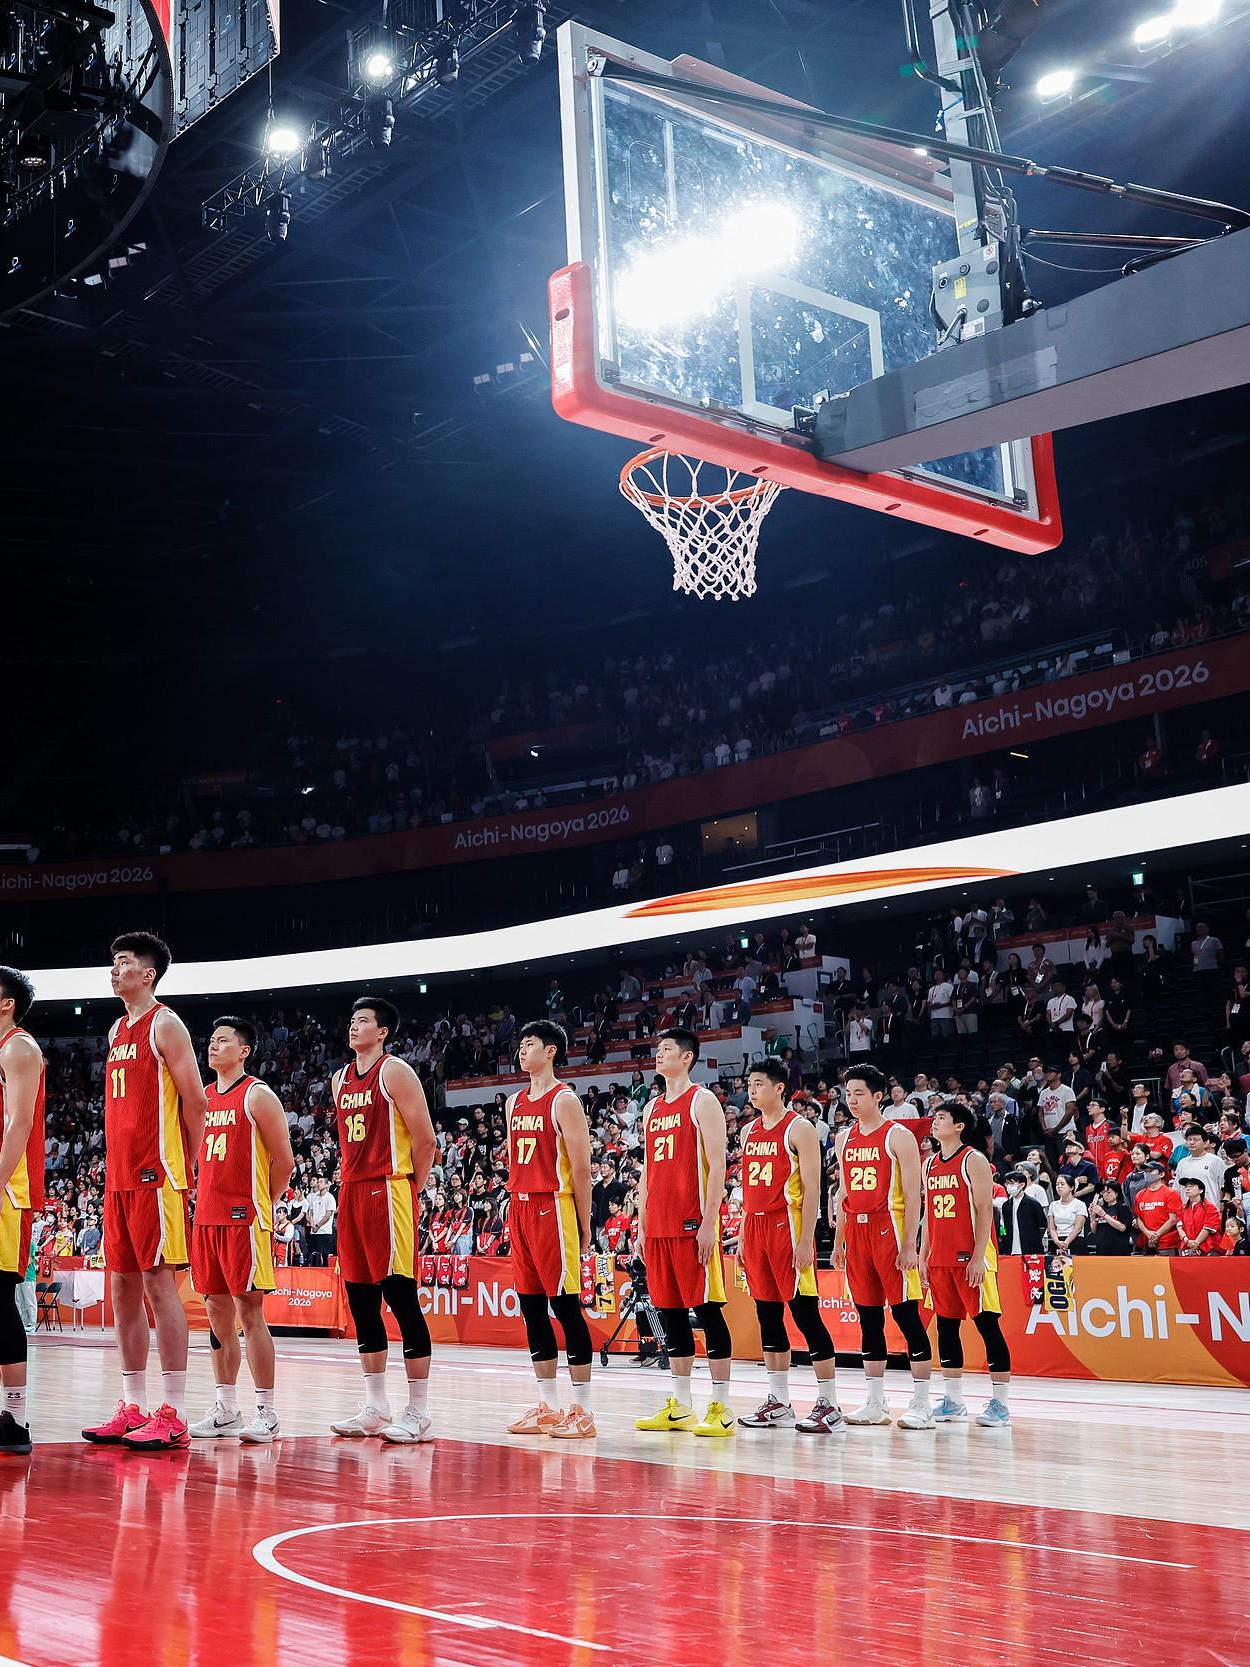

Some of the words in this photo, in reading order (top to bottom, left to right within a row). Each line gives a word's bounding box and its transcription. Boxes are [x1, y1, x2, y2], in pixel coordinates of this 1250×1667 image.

[962, 680, 1135, 740] Aichi-Nagoya
[1138, 661, 1210, 697] 2026
[454, 818, 585, 850] Aichi-Nagoya
[587, 805, 630, 830] 2026
[109, 866, 154, 884] 2026
[110, 1067, 126, 1098] 11
[205, 1109, 236, 1127] CHINA
[344, 1113, 366, 1142] 16
[511, 1115, 544, 1132] CHINA
[650, 1112, 681, 1133] CHINA
[205, 1133, 227, 1161] 14
[516, 1137, 537, 1164] 17
[654, 1134, 674, 1162] 21
[745, 1141, 778, 1156] CHINA
[845, 1147, 880, 1161] CHINA
[748, 1161, 772, 1186] 24
[850, 1166, 877, 1190] 26
[928, 1175, 959, 1190] CHINA
[932, 1194, 956, 1218] 32
[287, 1298, 312, 1307] 2026
